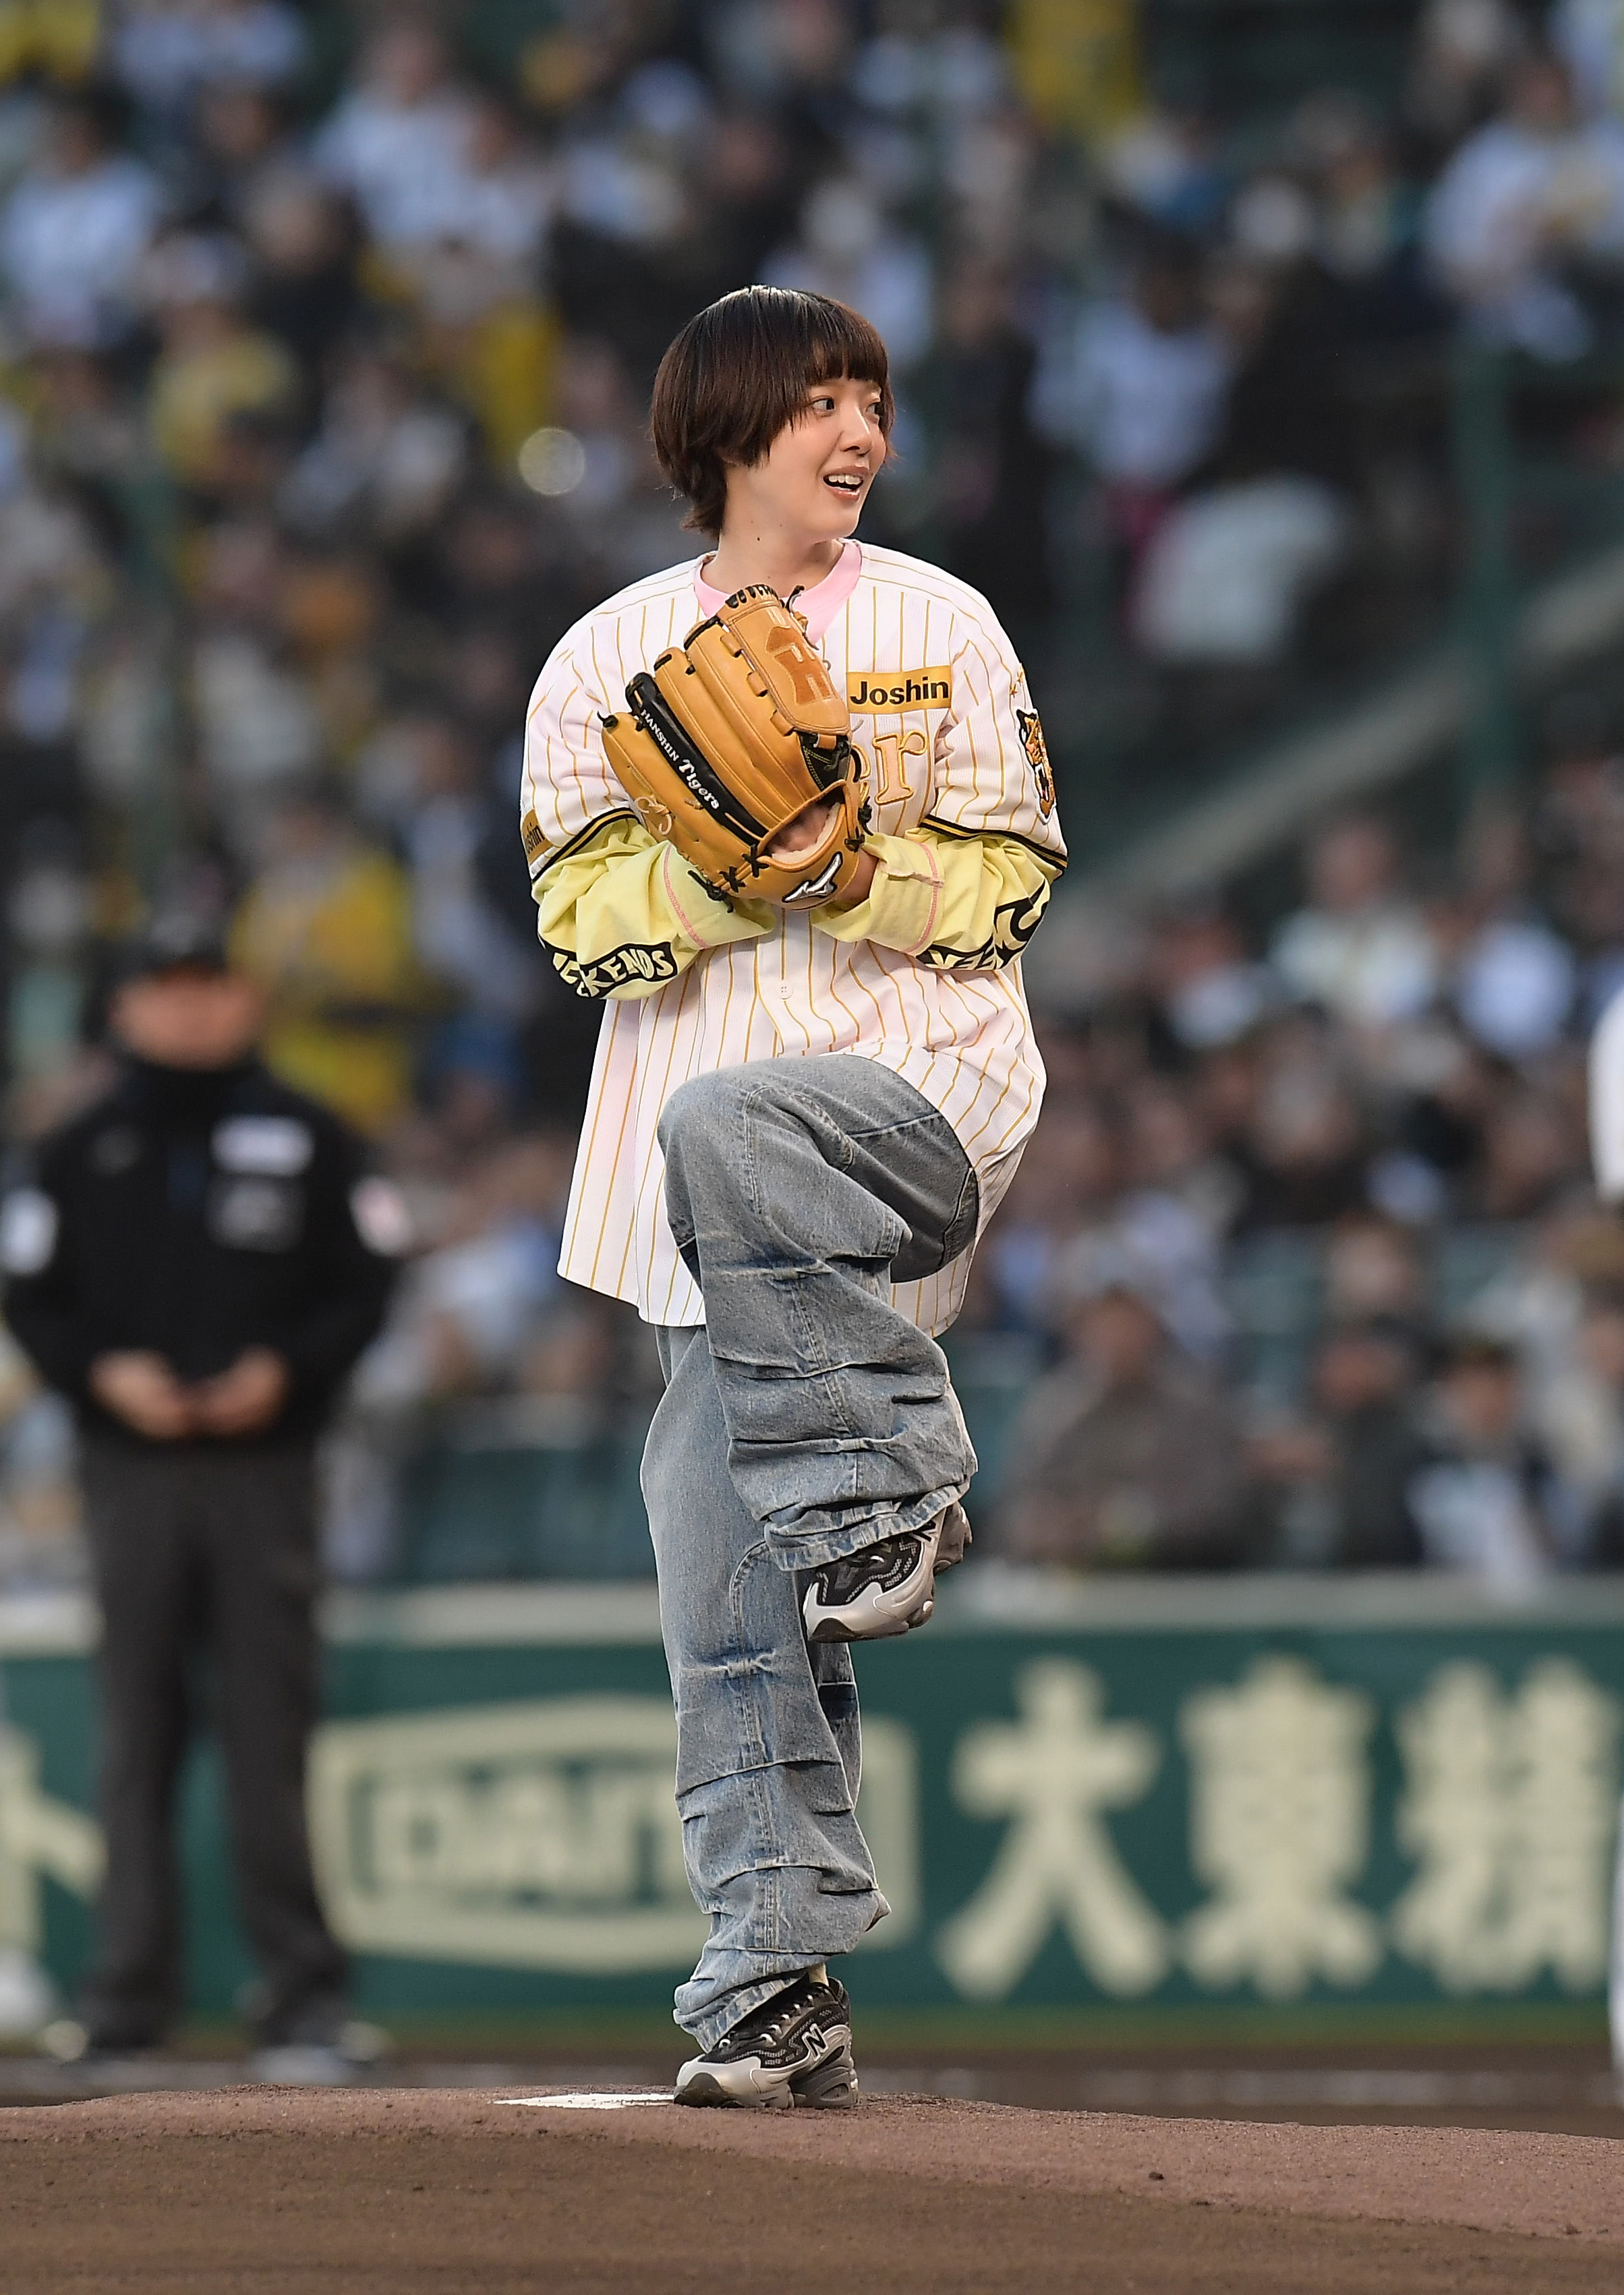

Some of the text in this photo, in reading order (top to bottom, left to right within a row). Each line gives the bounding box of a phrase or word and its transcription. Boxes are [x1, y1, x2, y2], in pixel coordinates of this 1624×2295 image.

[850, 676, 949, 705] Joshin
[641, 709, 720, 809] HANSHIN Tigers
